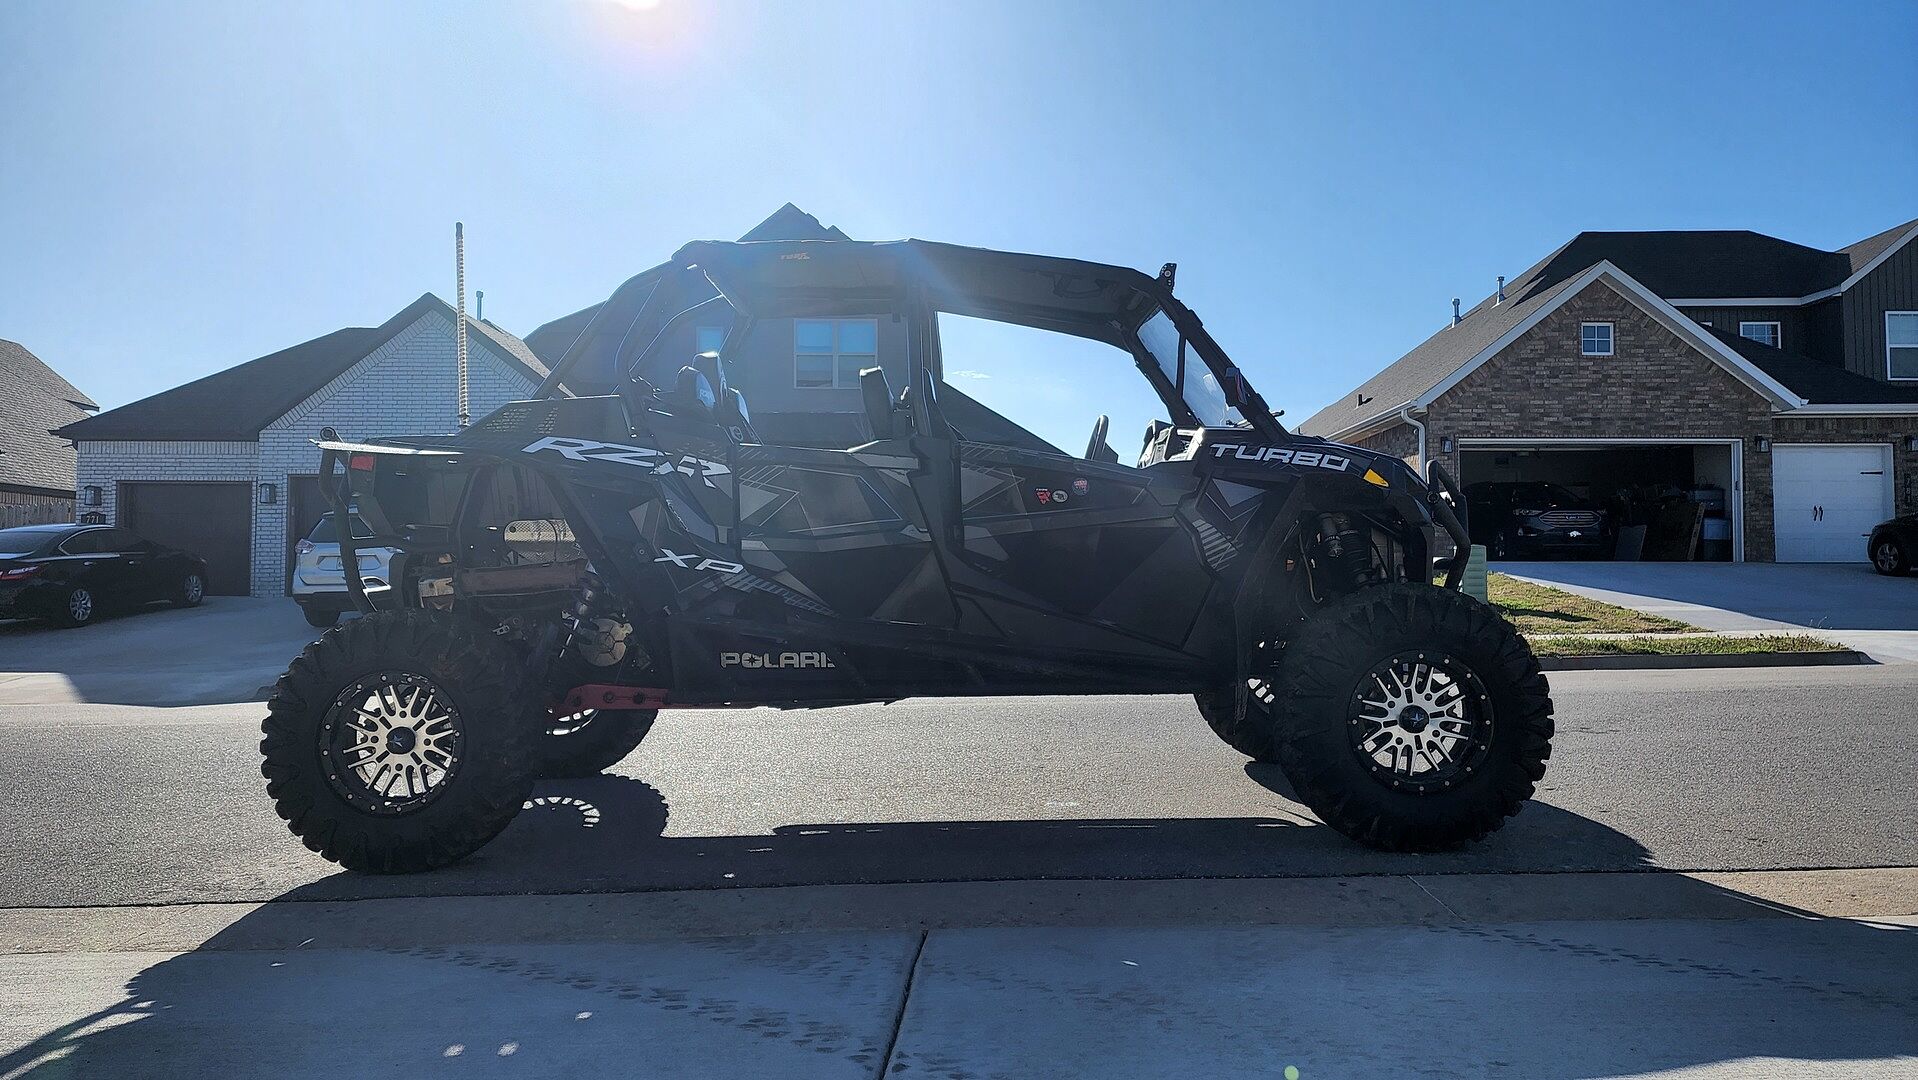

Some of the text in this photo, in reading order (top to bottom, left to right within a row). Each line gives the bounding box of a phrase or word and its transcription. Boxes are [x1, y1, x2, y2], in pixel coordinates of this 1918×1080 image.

[1210, 443, 1351, 472] TURBO
[86, 515, 99, 524] 771
[653, 548, 744, 574] XP
